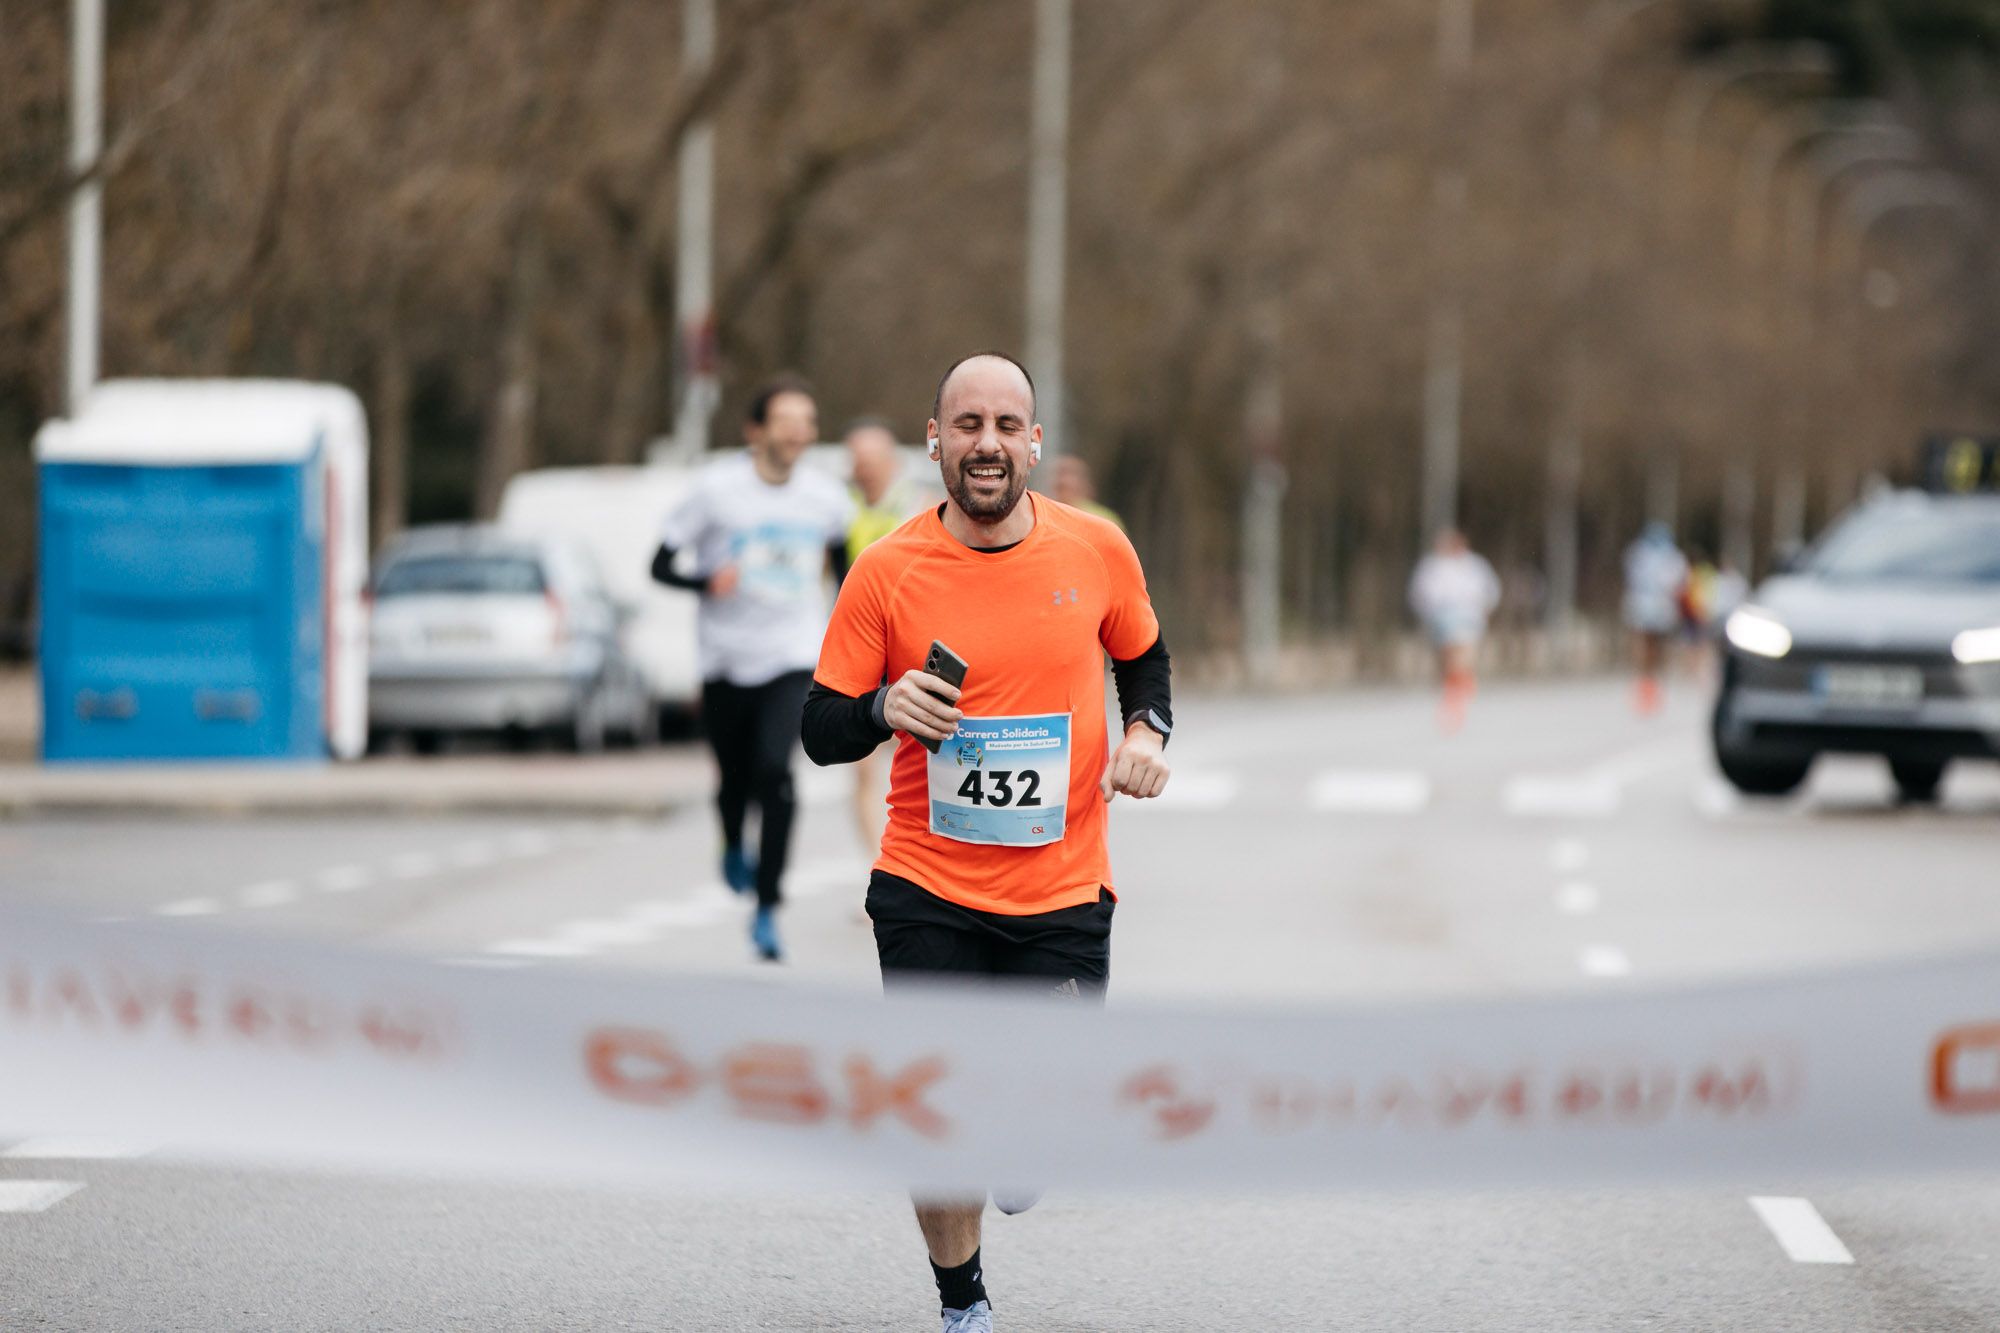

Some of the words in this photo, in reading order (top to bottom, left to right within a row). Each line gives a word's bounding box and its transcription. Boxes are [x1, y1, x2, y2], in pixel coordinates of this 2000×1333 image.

[957, 728, 999, 739] Carrera
[1002, 727, 1049, 739] Solidaria
[957, 769, 1041, 807] 432
[1032, 826, 1044, 834] CSL
